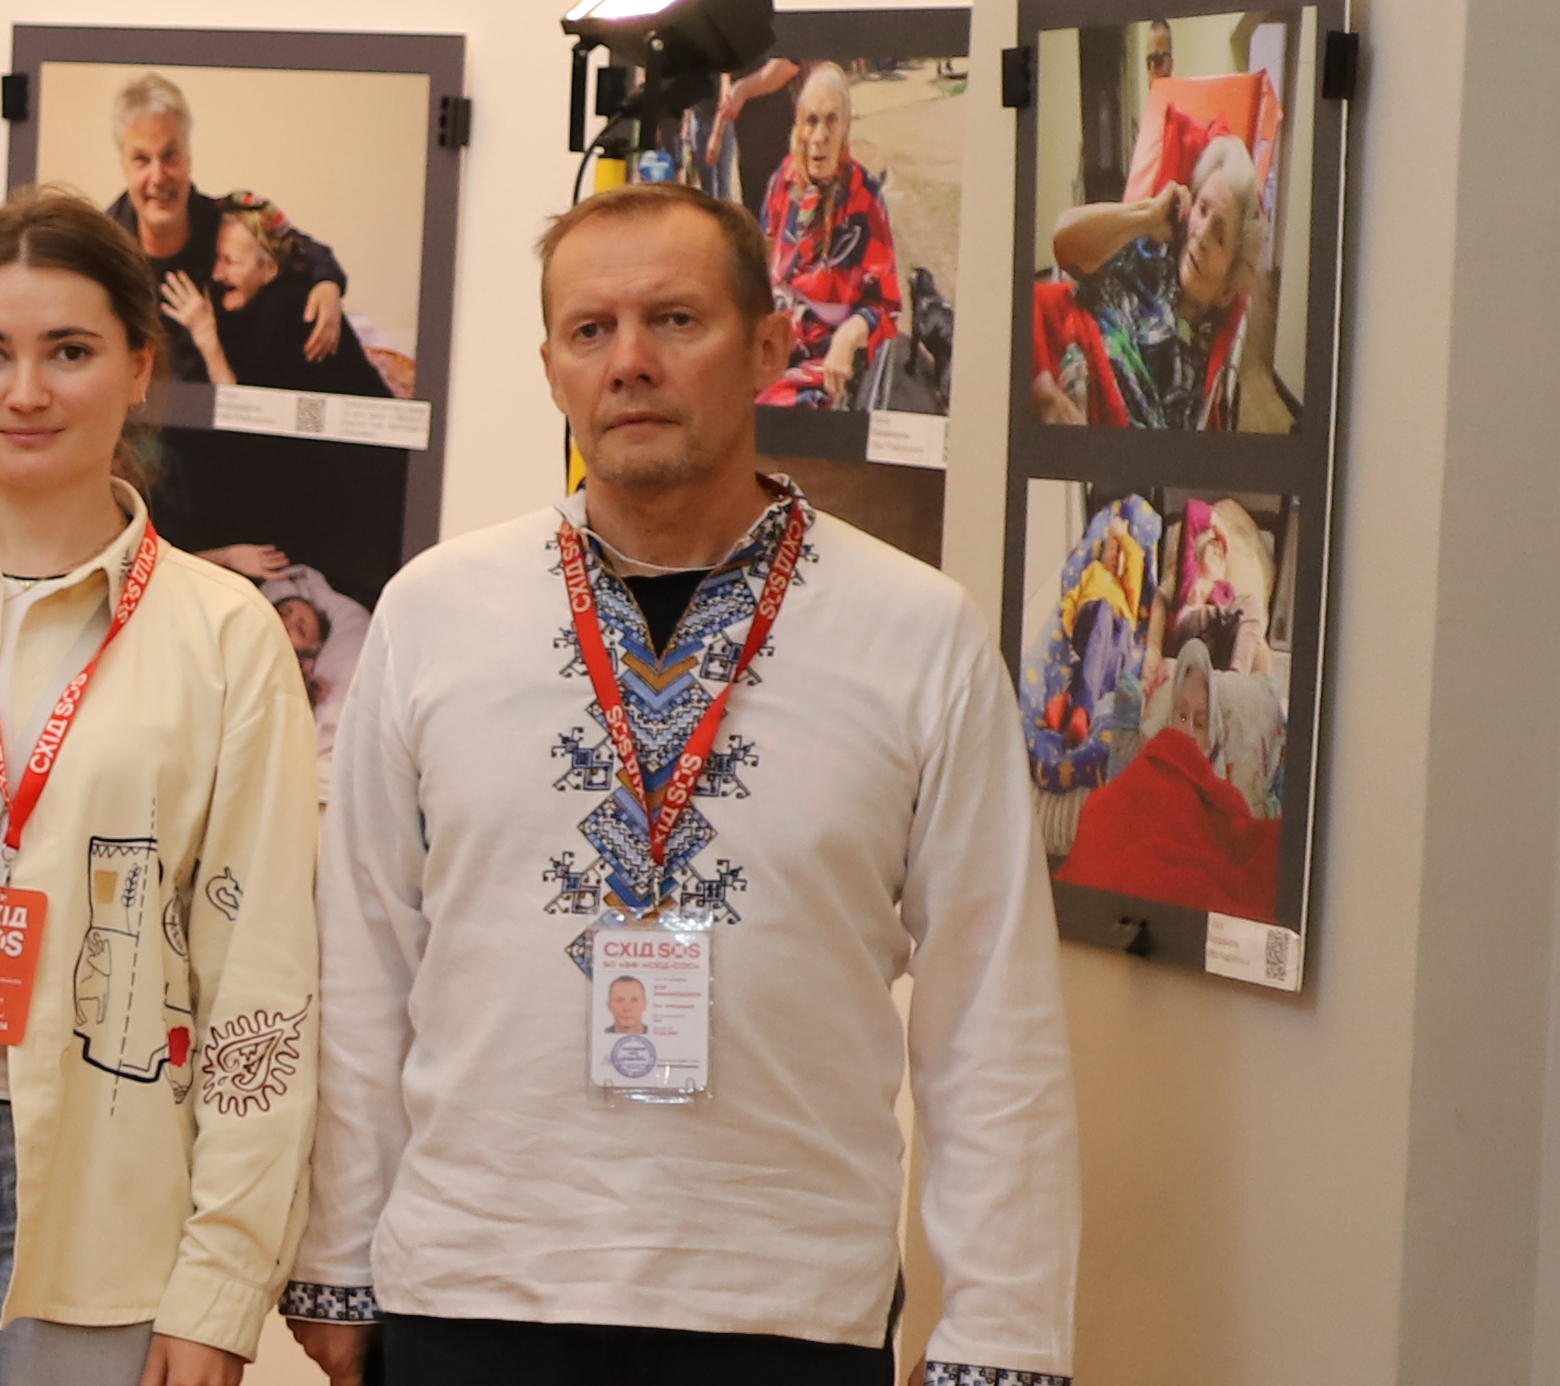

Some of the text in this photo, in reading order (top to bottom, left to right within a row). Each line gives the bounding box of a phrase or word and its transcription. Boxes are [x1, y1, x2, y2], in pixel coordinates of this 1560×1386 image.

[117, 537, 158, 624] СХІД SOS
[564, 562, 591, 613] СХІД
[760, 520, 803, 620] СХІД SOS
[29, 673, 88, 773] СХІД SOS
[606, 705, 632, 756] SOS
[655, 753, 702, 844] ХІД SOS
[603, 941, 702, 959] СХІД SOS
